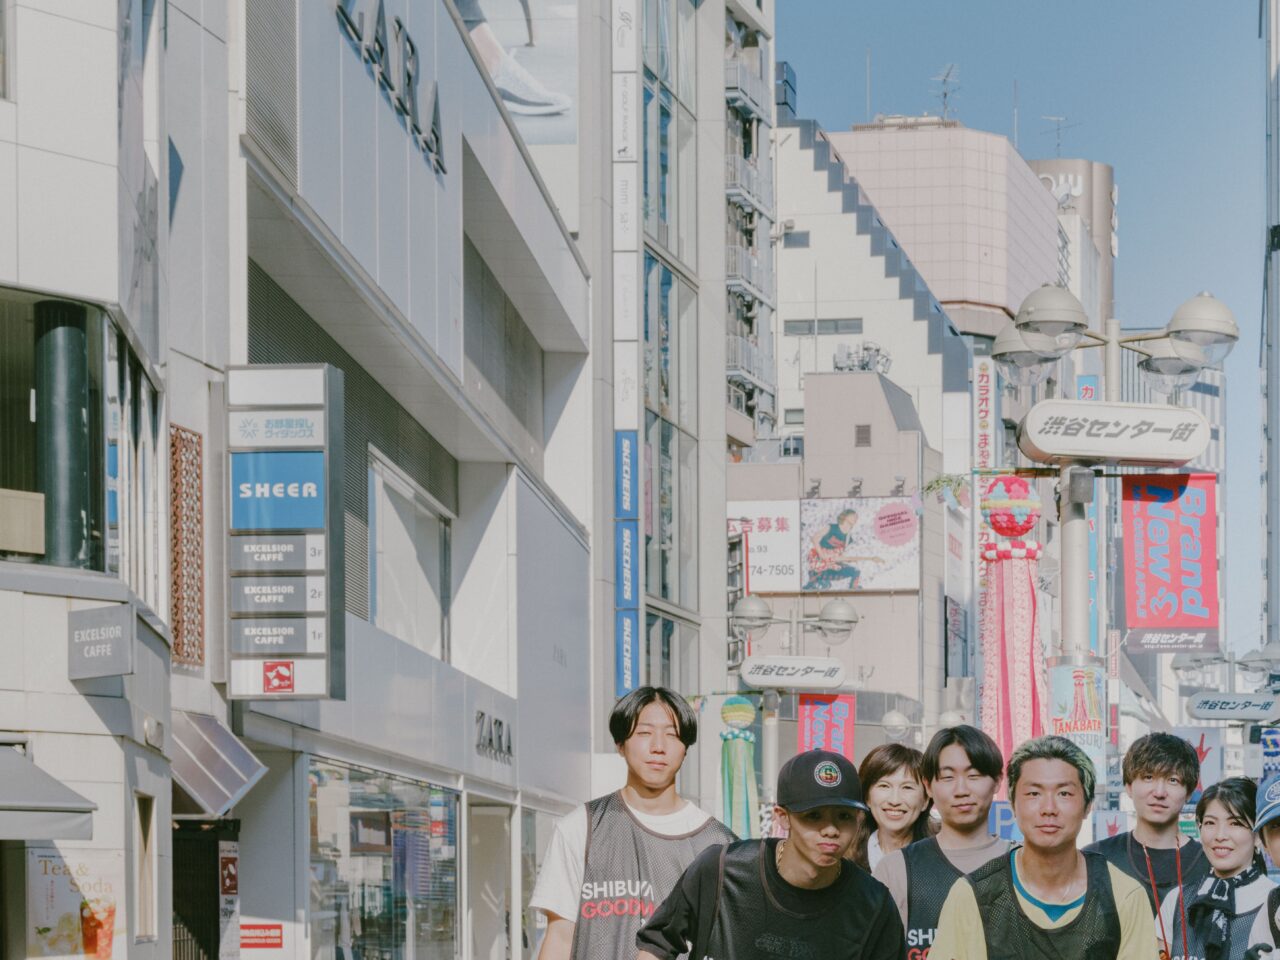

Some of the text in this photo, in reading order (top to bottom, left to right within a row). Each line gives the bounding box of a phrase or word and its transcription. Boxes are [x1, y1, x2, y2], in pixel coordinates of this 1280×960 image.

[336, 0, 447, 175] ARA
[1038, 416, 1198, 442] 渋谷センター街
[622, 438, 632, 511] SKECHERS
[239, 482, 318, 498] SHEER
[1146, 484, 1176, 583] New
[243, 544, 294, 553] EXCELSIOR
[310, 547, 323, 557] 3F
[1178, 485, 1210, 618] Brand
[623, 528, 632, 601] SKECHERS
[244, 586, 294, 594] EXCELSIOR
[310, 589, 323, 599] 2F
[74, 625, 122, 642] EXCELSIOR
[244, 627, 294, 636] EXCELSIOR
[311, 630, 323, 640] 1F
[623, 617, 632, 689] SKECHERS
[748, 664, 841, 678] 渋谷センター街
[1196, 699, 1275, 711] 渋谷センター街
[476, 710, 513, 758] ZARA
[1052, 717, 1102, 737] TANABATA
[38, 858, 72, 876] Tea
[69, 878, 112, 893] Soda
